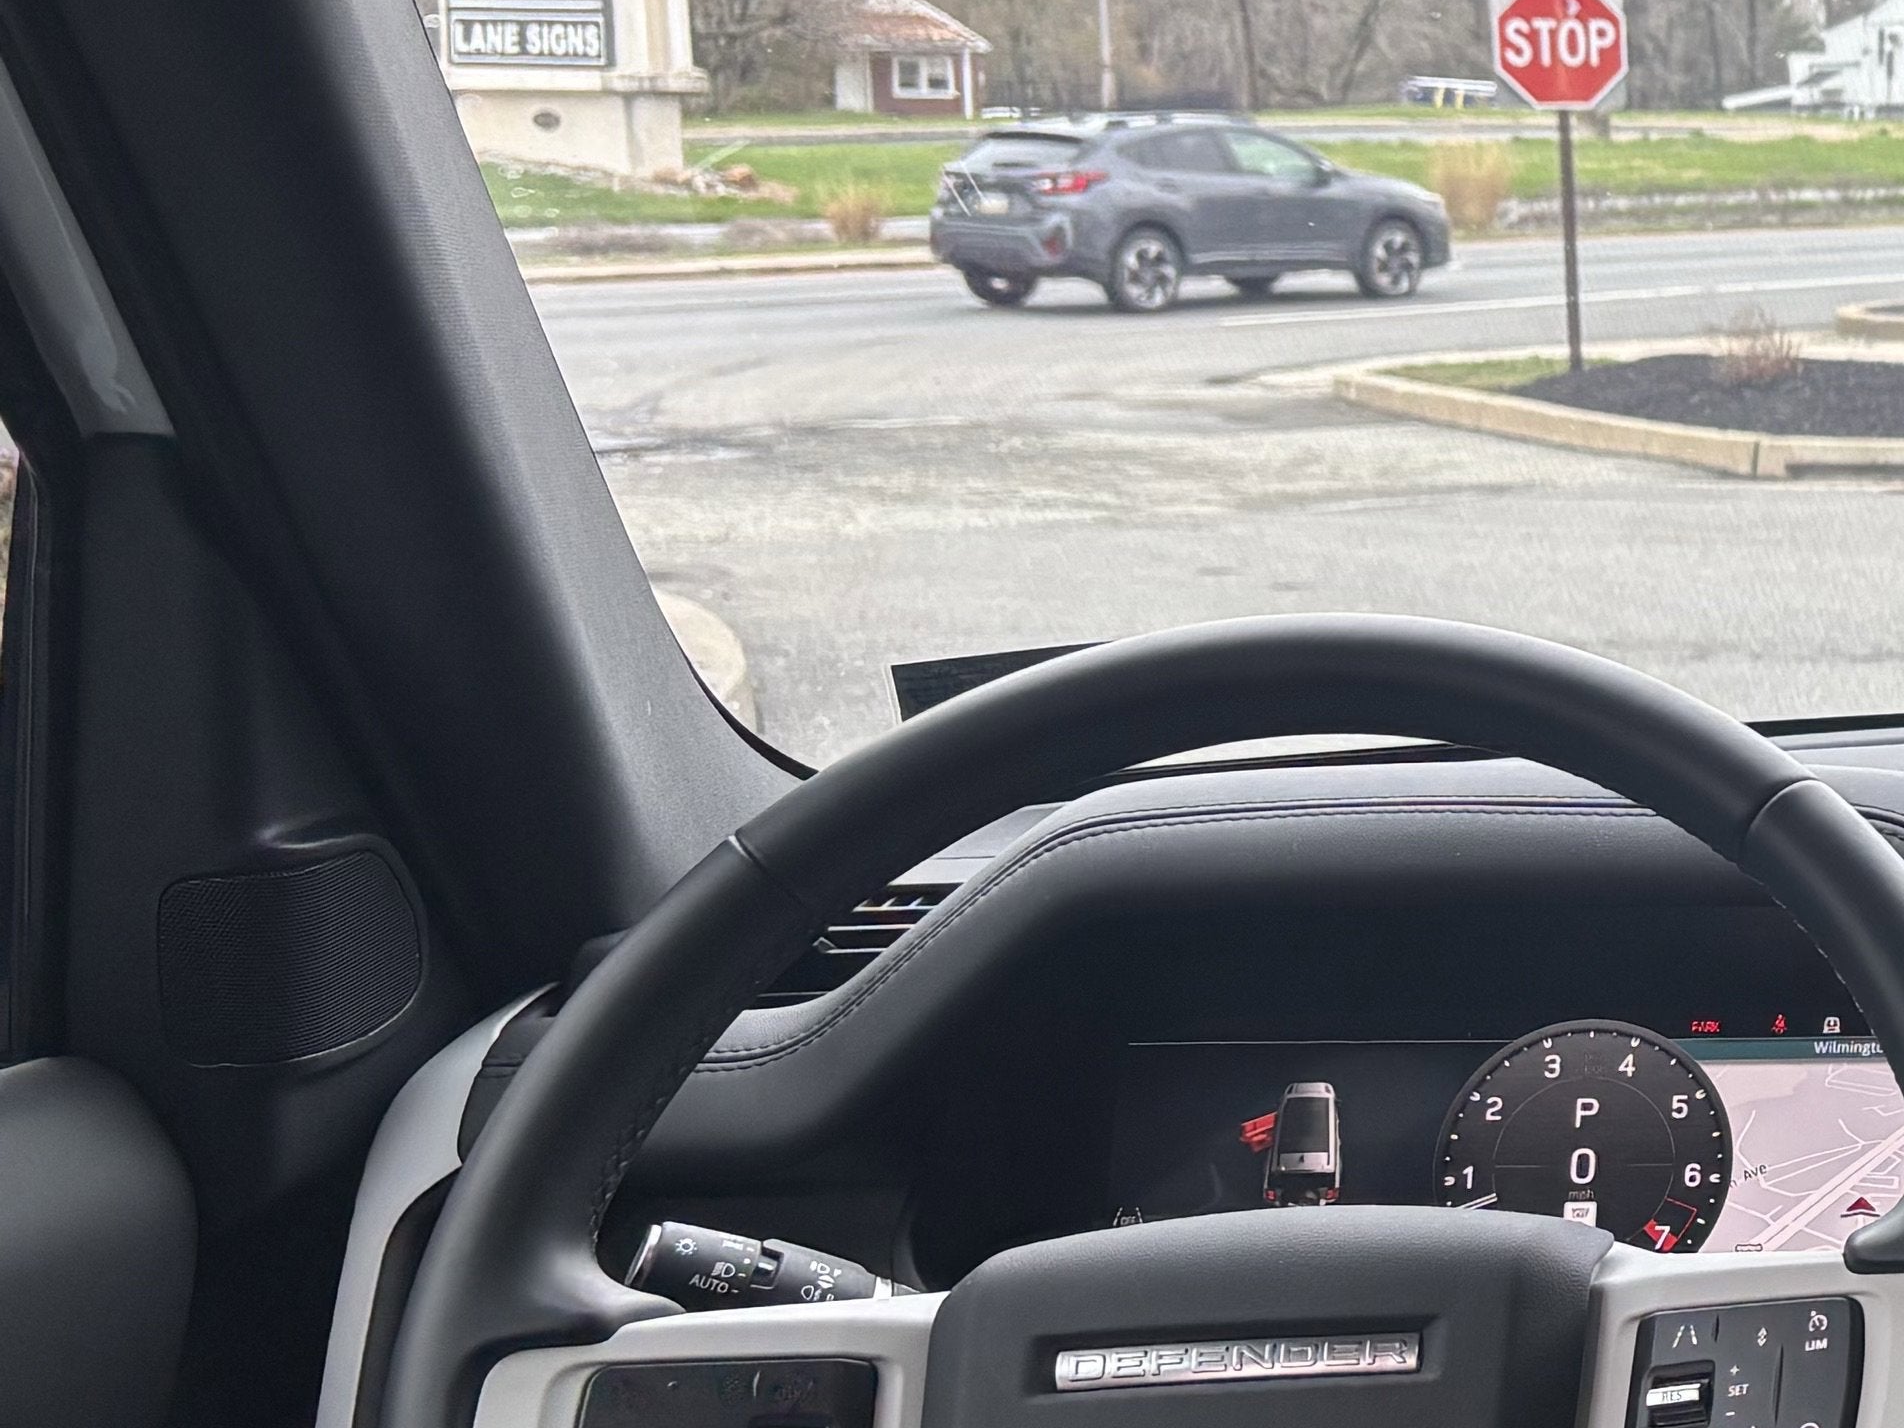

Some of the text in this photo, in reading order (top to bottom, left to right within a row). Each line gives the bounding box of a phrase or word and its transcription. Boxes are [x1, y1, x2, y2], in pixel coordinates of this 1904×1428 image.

[454, 22, 600, 56] LANE SIGNS
[1504, 16, 1617, 68] STOP
[1543, 1054, 1561, 1078] 3
[1618, 1053, 1636, 1077] 4
[1485, 1096, 1503, 1121] 2
[1574, 1097, 1600, 1128] P
[1671, 1094, 1689, 1119] 5
[1462, 1165, 1475, 1189] 1
[1569, 1147, 1597, 1185] 0
[1684, 1162, 1702, 1188] 6
[1653, 1224, 1671, 1250] 7
[689, 1273, 729, 1294] AUTO
[1804, 1338, 1828, 1352] LIM
[1067, 1339, 1409, 1382] DEFENDER
[1662, 1391, 1683, 1403] RES
[1727, 1384, 1750, 1398] SET
